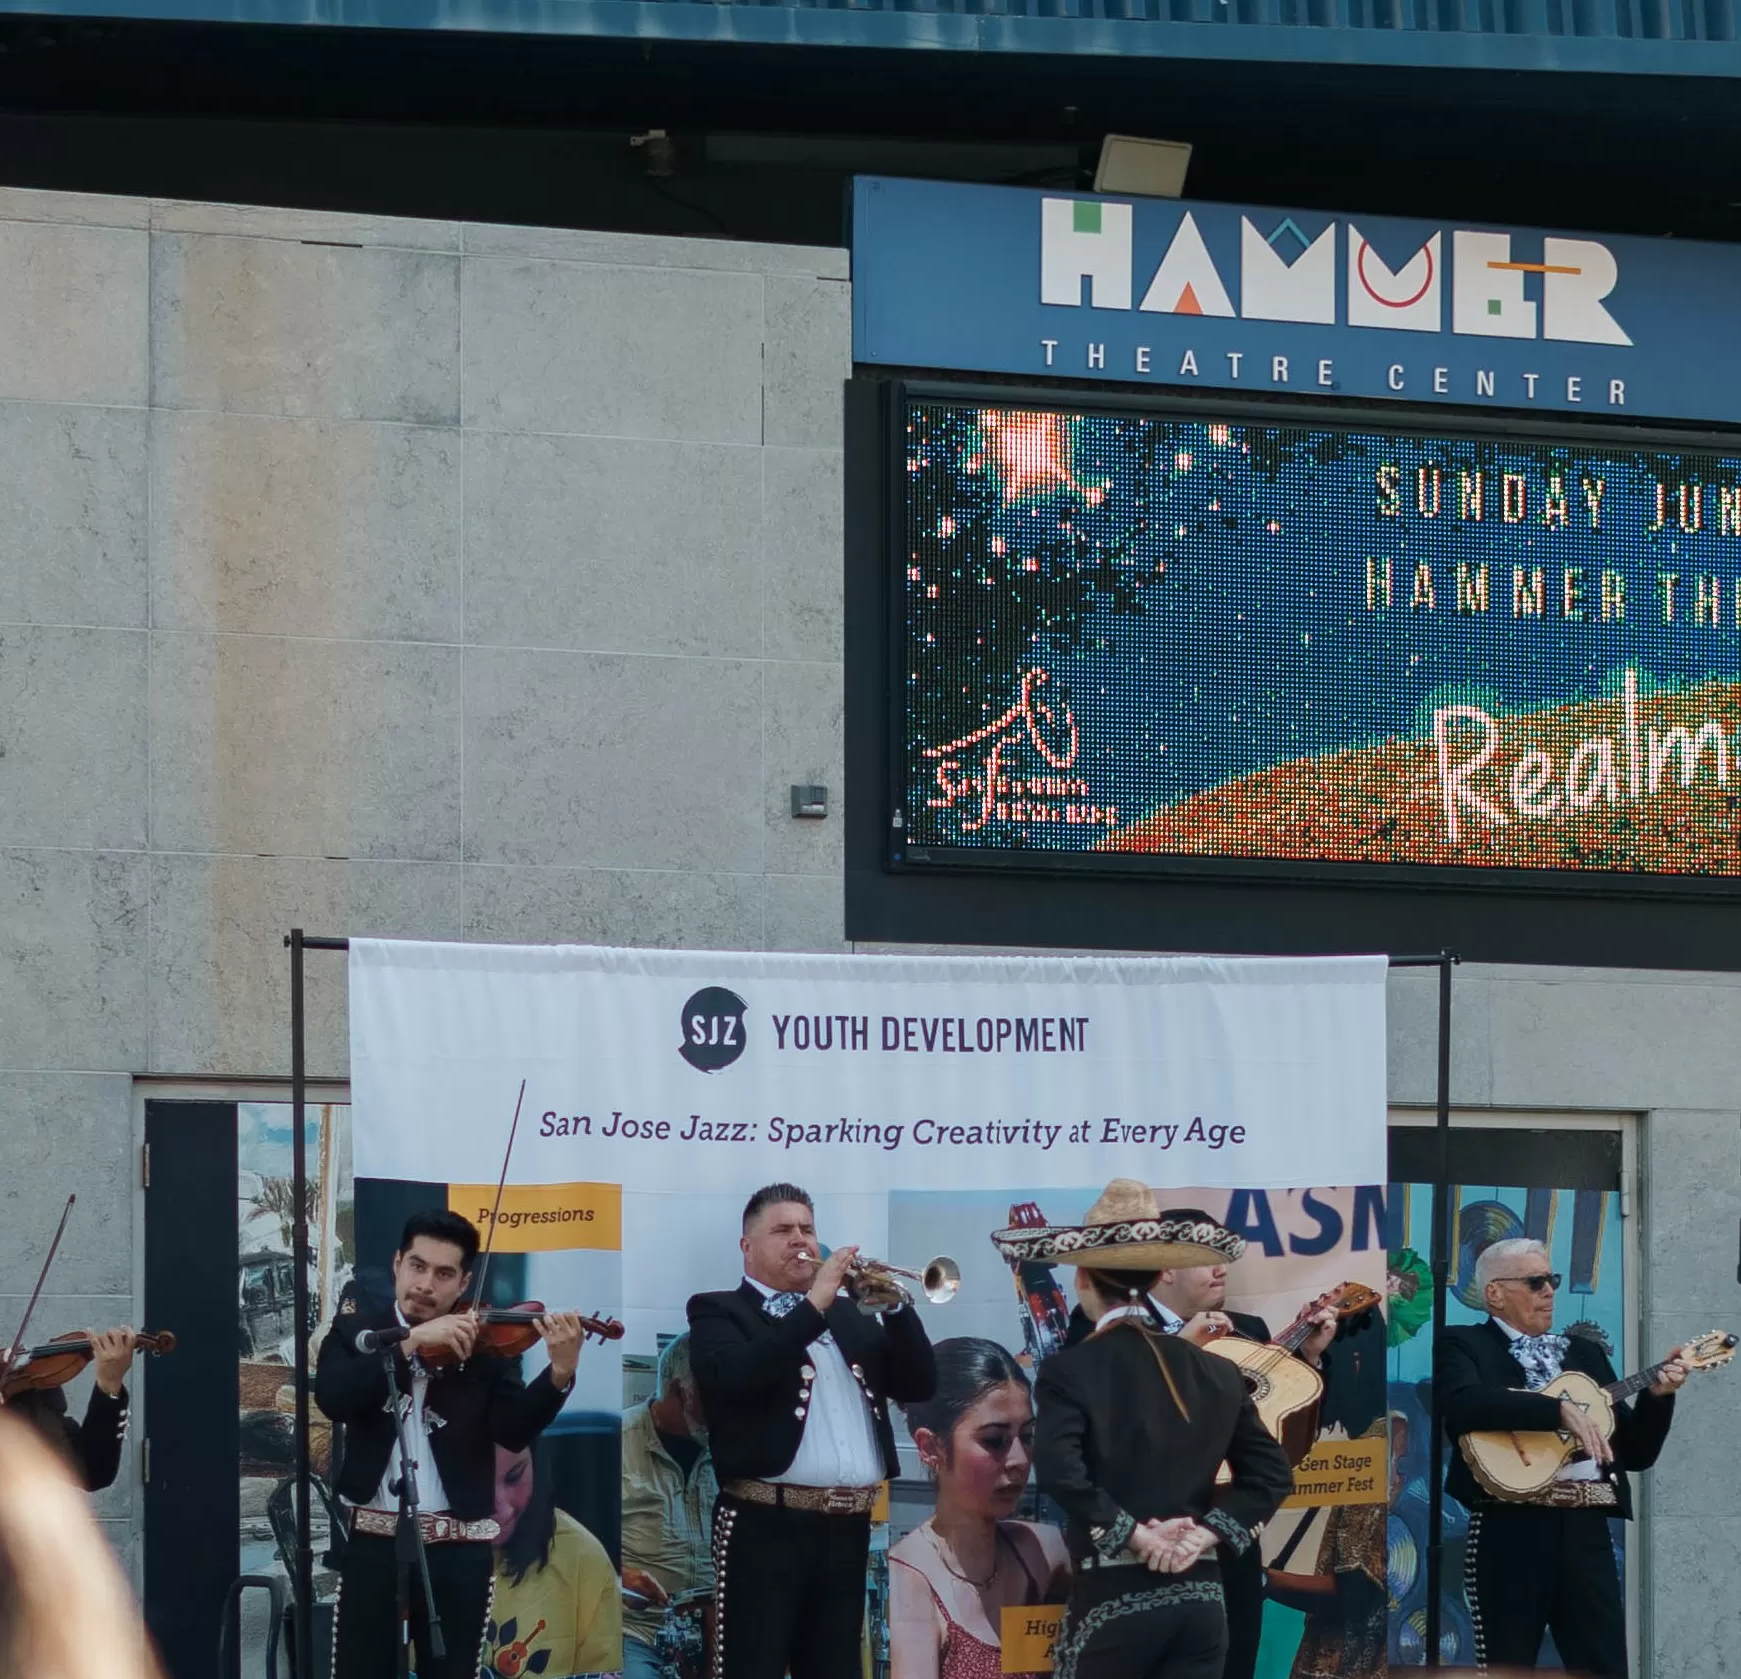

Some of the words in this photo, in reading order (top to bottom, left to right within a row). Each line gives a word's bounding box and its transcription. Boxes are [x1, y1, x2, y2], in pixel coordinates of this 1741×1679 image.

[1041, 198, 1633, 346] HAMMER
[1042, 340, 1334, 387] THEATRE
[1389, 344, 1627, 406] CENTER
[1377, 466, 1606, 529] SUNDAY
[1366, 556, 1626, 624] HAMMER
[691, 1014, 738, 1046] SJZ
[772, 1015, 869, 1051] YOUTH
[881, 1016, 1090, 1053] DEVELOPMENT
[539, 1111, 591, 1137] San
[602, 1112, 671, 1140] Jose
[680, 1115, 758, 1143] Jazz:
[767, 1117, 903, 1150] Sparking
[913, 1118, 1062, 1150] Creativity
[1068, 1119, 1091, 1143] at
[1100, 1118, 1179, 1150] Every
[1183, 1116, 1246, 1149] Age
[1292, 1481, 1344, 1496] mmer
[1346, 1477, 1375, 1493] Fest
[1333, 1455, 1372, 1472] Stage
